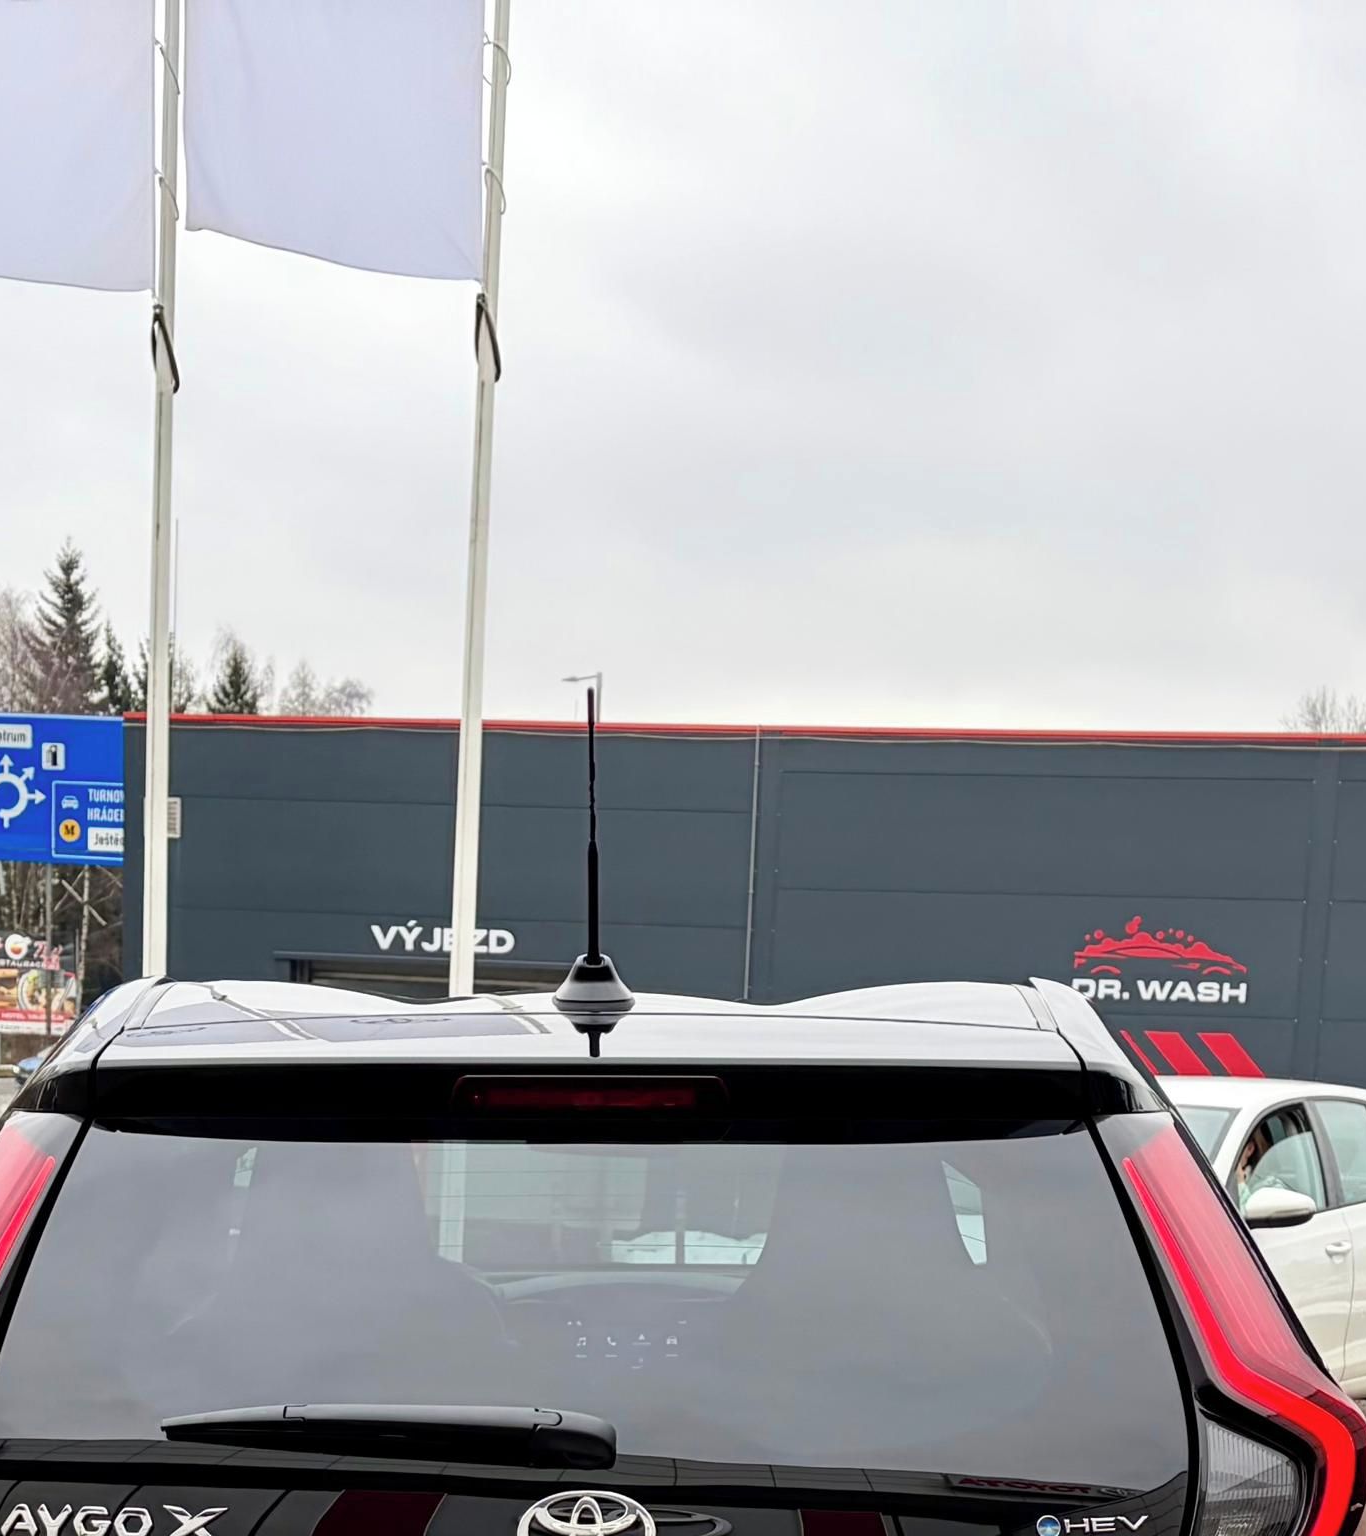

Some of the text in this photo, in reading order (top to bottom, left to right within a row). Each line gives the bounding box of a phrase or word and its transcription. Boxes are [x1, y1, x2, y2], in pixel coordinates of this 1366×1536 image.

[1070, 978, 1248, 1004] DR. WASH
[1063, 1514, 1149, 1534] HEV
